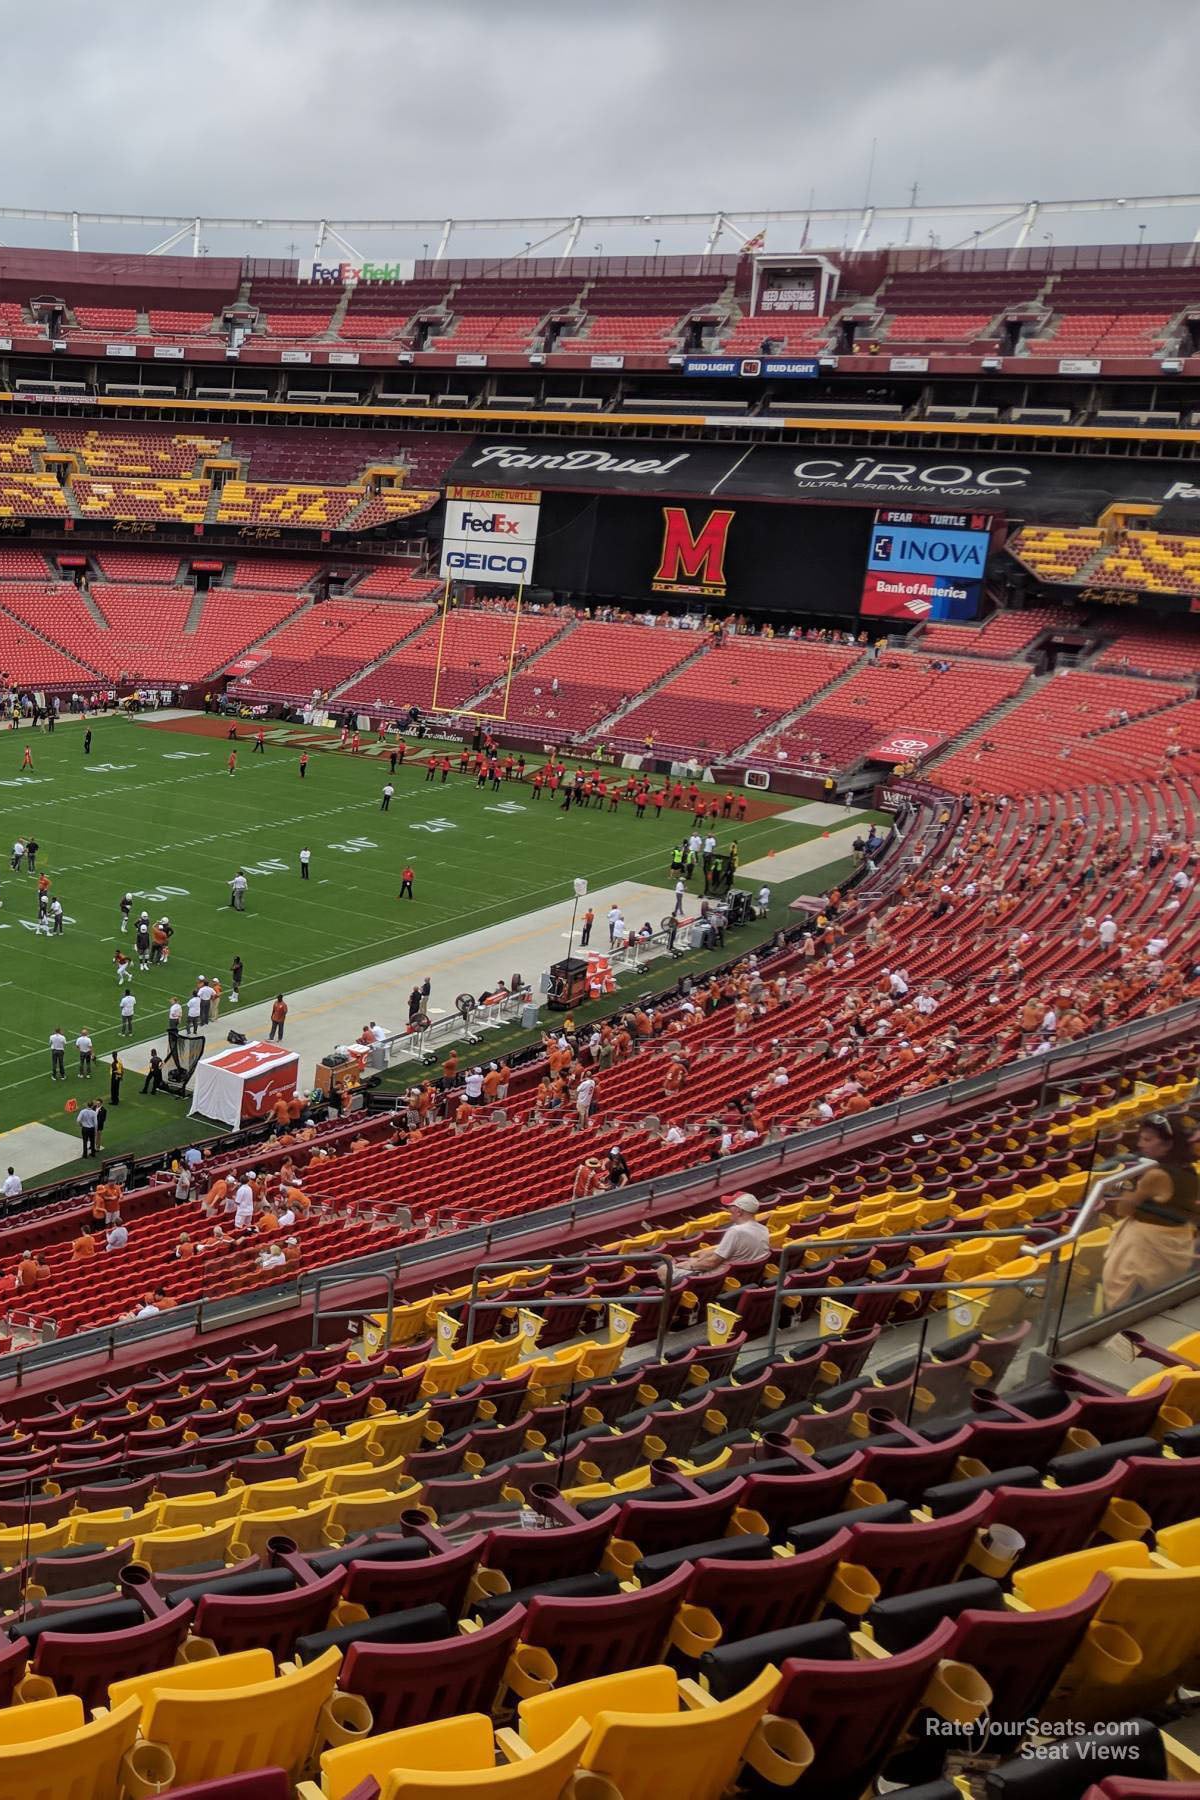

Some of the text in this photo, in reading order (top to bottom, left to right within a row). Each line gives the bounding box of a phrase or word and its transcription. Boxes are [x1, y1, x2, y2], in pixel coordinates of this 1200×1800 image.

[312, 262, 401, 281] FedExField
[766, 364, 786, 372] BUD
[471, 446, 690, 474] FanDuel
[793, 457, 1032, 487] CÎROC
[798, 481, 1001, 496] ULTRA PREMIUM VODKA
[460, 511, 520, 535] FedEx
[653, 507, 736, 584] M
[900, 539, 982, 565] INOVA
[446, 551, 527, 574] GEICO
[876, 581, 967, 600] Bank of America
[484, 801, 528, 815] 10
[409, 818, 457, 833] 20
[328, 837, 379, 853] 30
[244, 858, 290, 877] 40
[134, 885, 191, 903] 50
